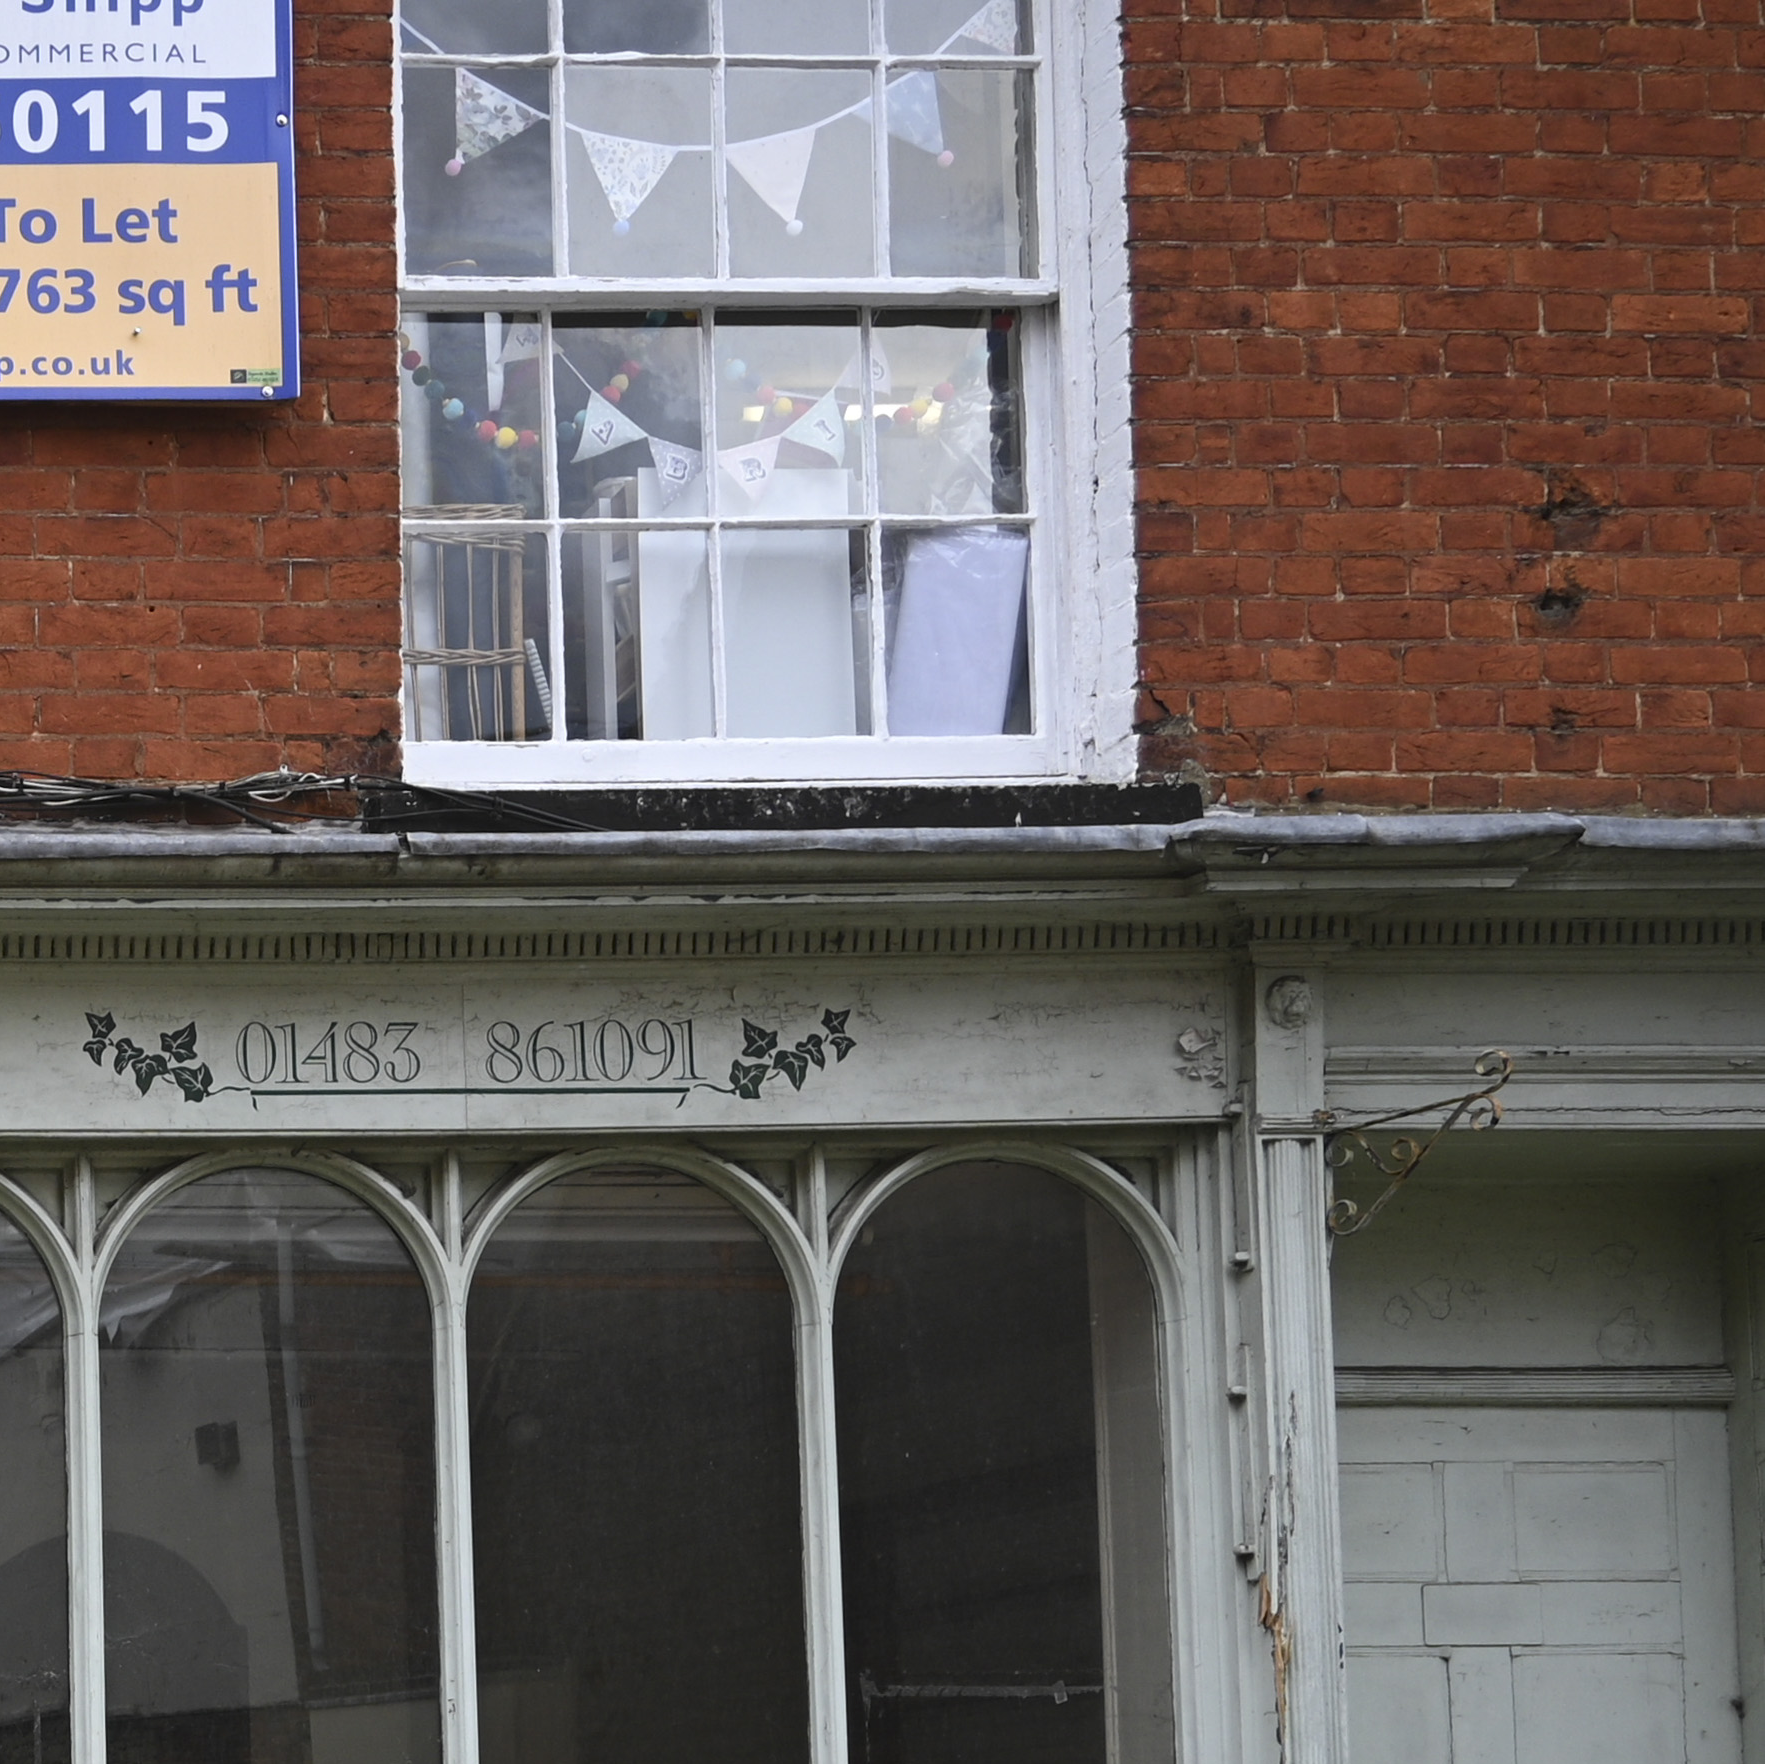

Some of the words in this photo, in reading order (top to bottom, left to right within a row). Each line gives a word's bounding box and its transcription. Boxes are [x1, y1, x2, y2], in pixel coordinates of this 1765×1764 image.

[81, 197, 179, 245] Let
[117, 278, 187, 327] sq
[205, 265, 259, 314] ft
[235, 1020, 423, 1085] 01483
[483, 1017, 709, 1085] 861091
